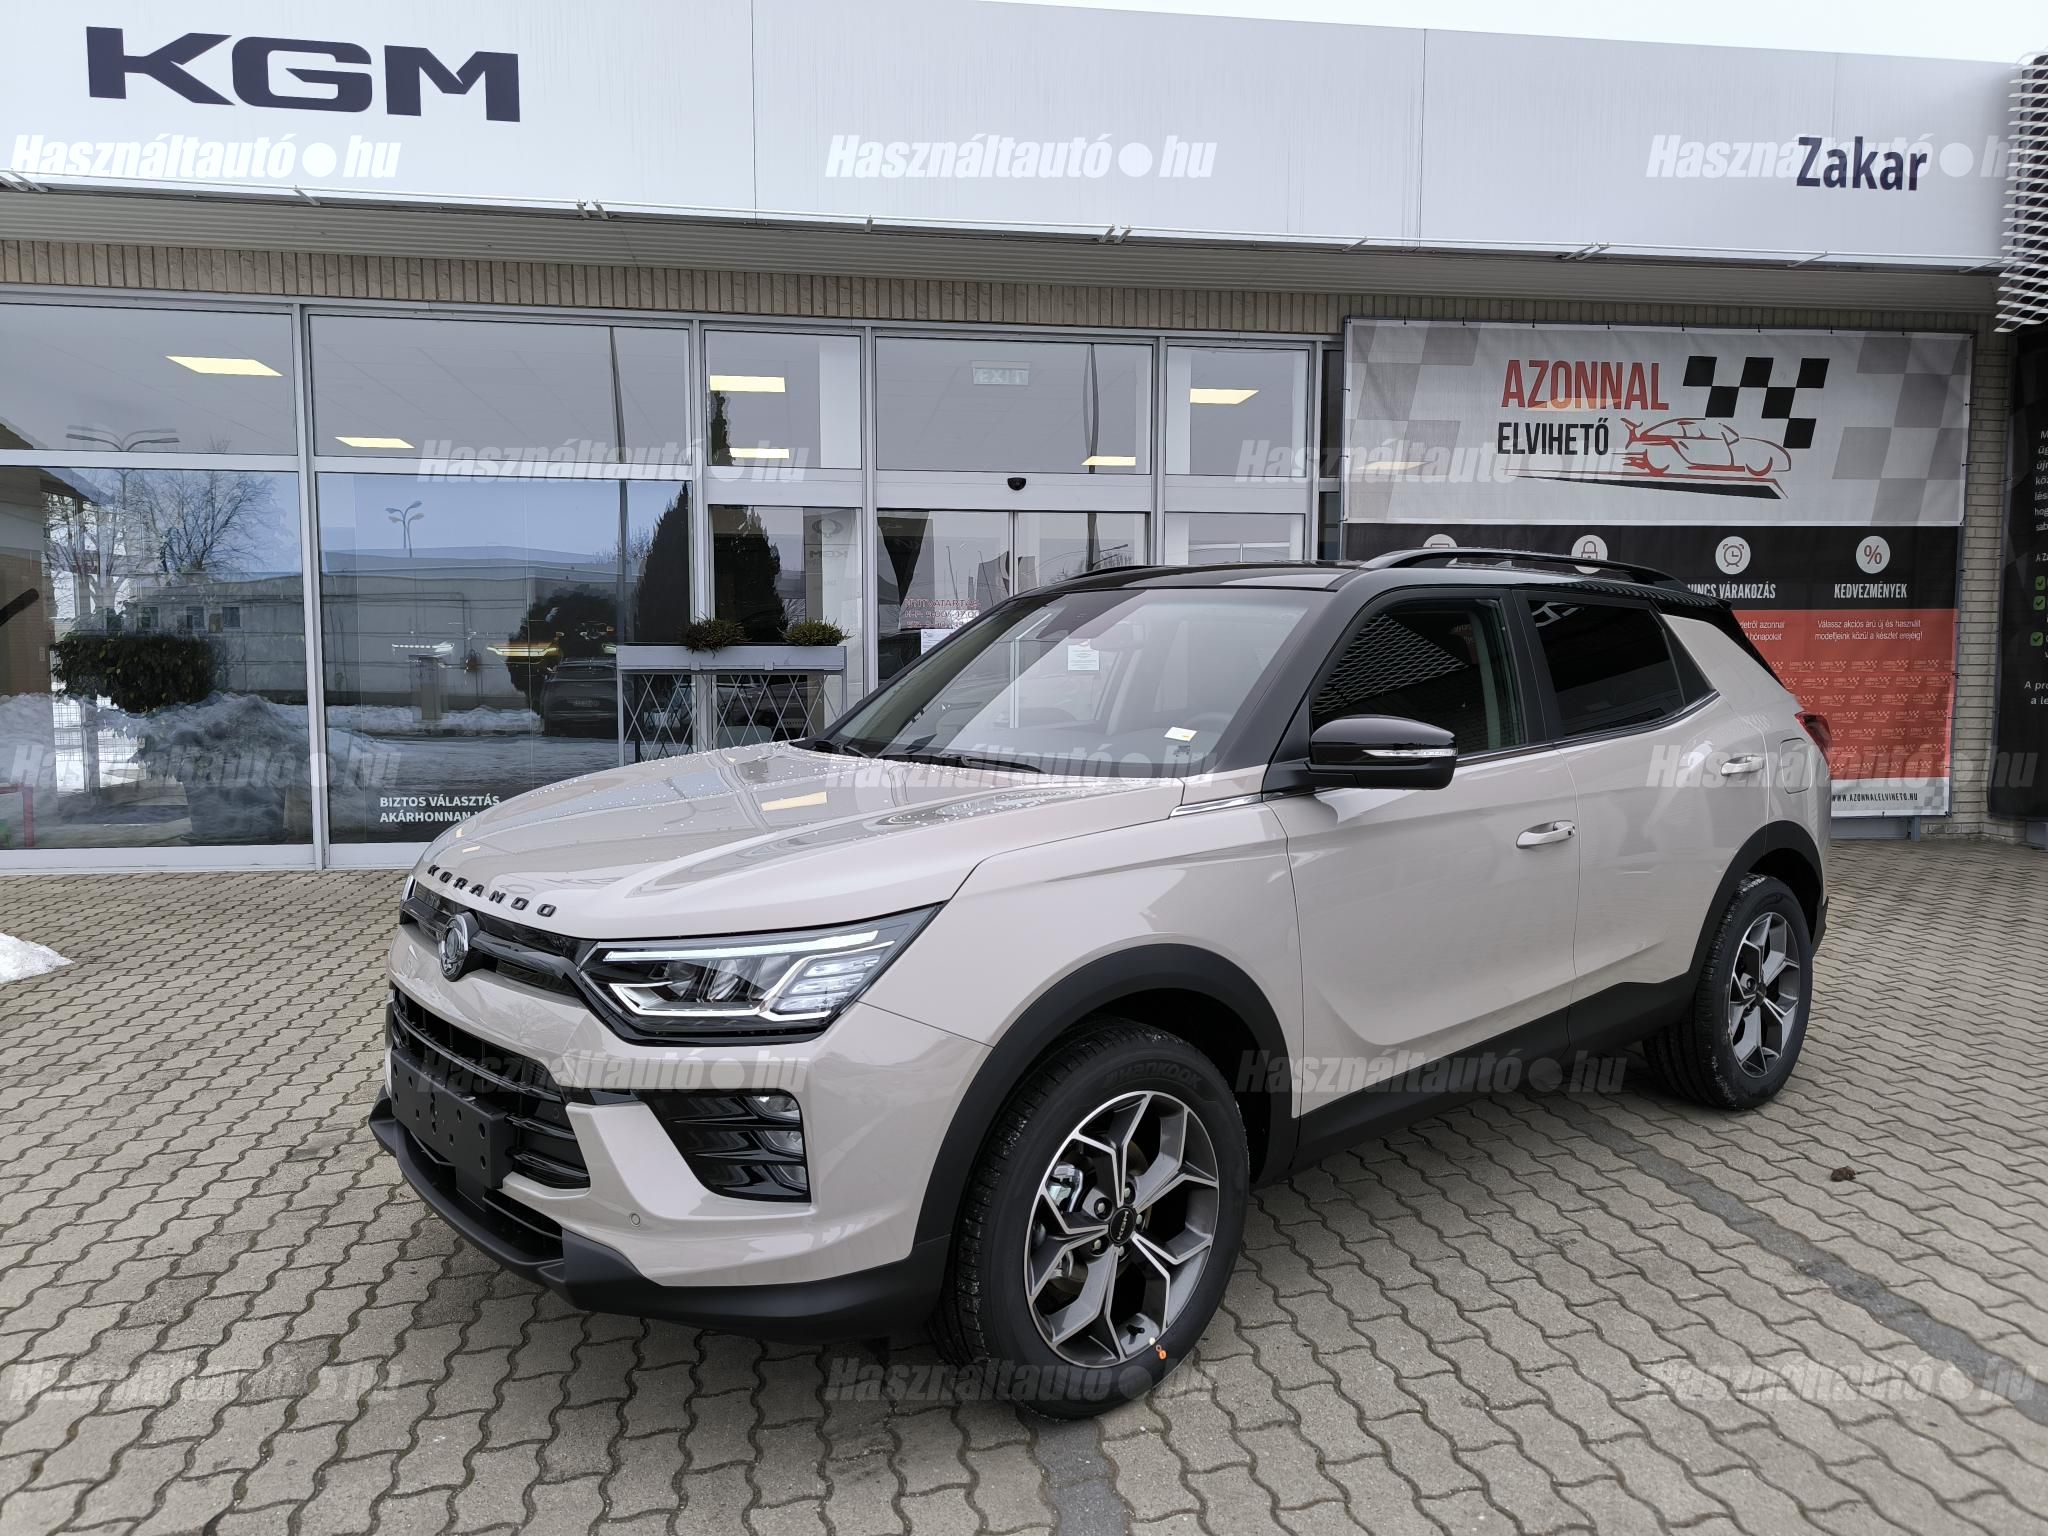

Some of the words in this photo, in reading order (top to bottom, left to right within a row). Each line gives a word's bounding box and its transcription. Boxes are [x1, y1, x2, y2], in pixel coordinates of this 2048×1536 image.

[86, 26, 521, 122] KGM
[1796, 136, 1928, 191] Zakar
[1501, 360, 1670, 411] AZONNAL
[1497, 417, 1610, 456] ELVIHETŐ
[1718, 580, 1777, 600] VÁRAKOZÁS
[1833, 581, 1908, 599] KEDVEZMÉNYEK
[379, 809, 471, 823] AKÁRHONNAN
[380, 796, 427, 808] BIZTOS
[428, 792, 500, 807] VÁLASZTÁS
[427, 864, 557, 918] KORANDO
